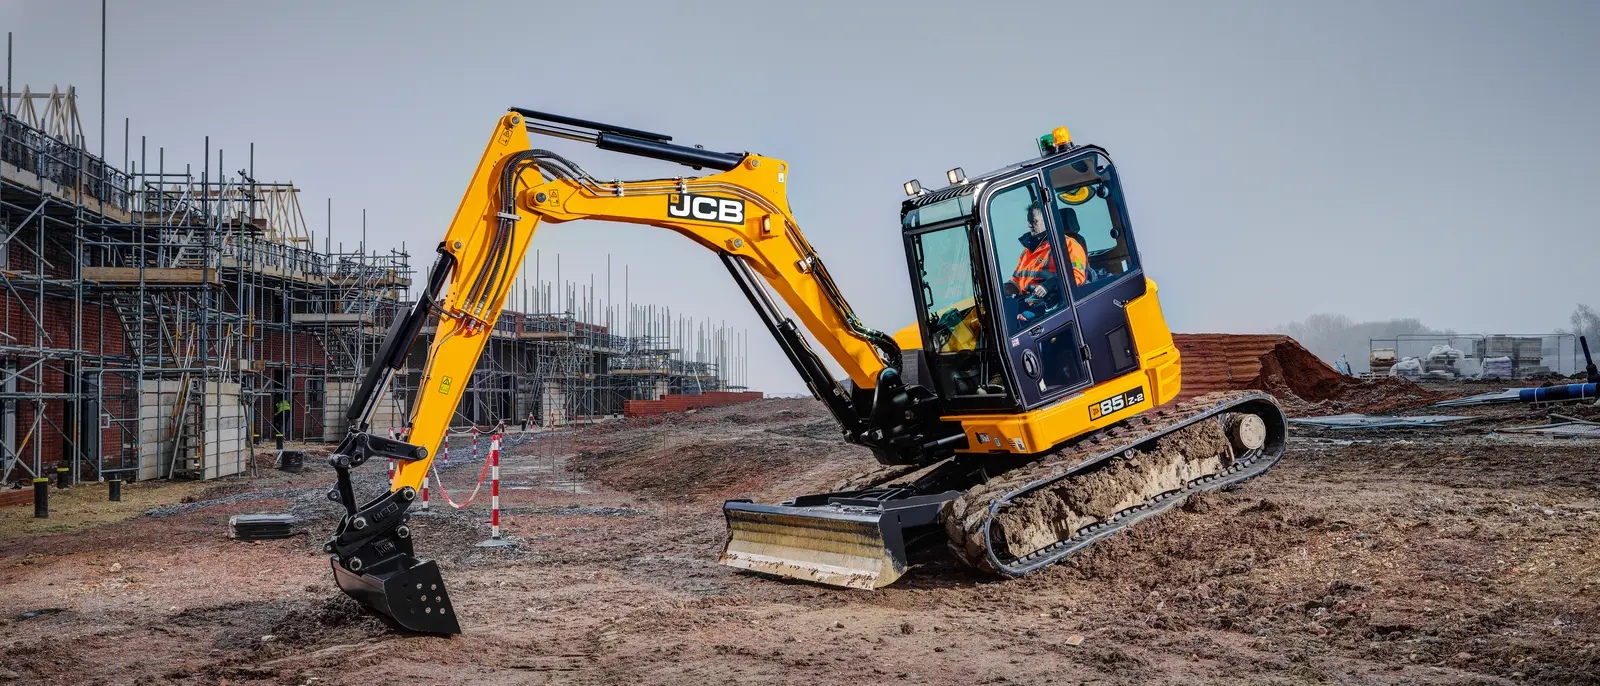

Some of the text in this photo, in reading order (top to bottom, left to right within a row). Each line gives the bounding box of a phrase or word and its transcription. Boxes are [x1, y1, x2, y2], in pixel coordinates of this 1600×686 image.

[670, 195, 743, 223] JCB
[1100, 393, 1144, 415] 85 Z-2
